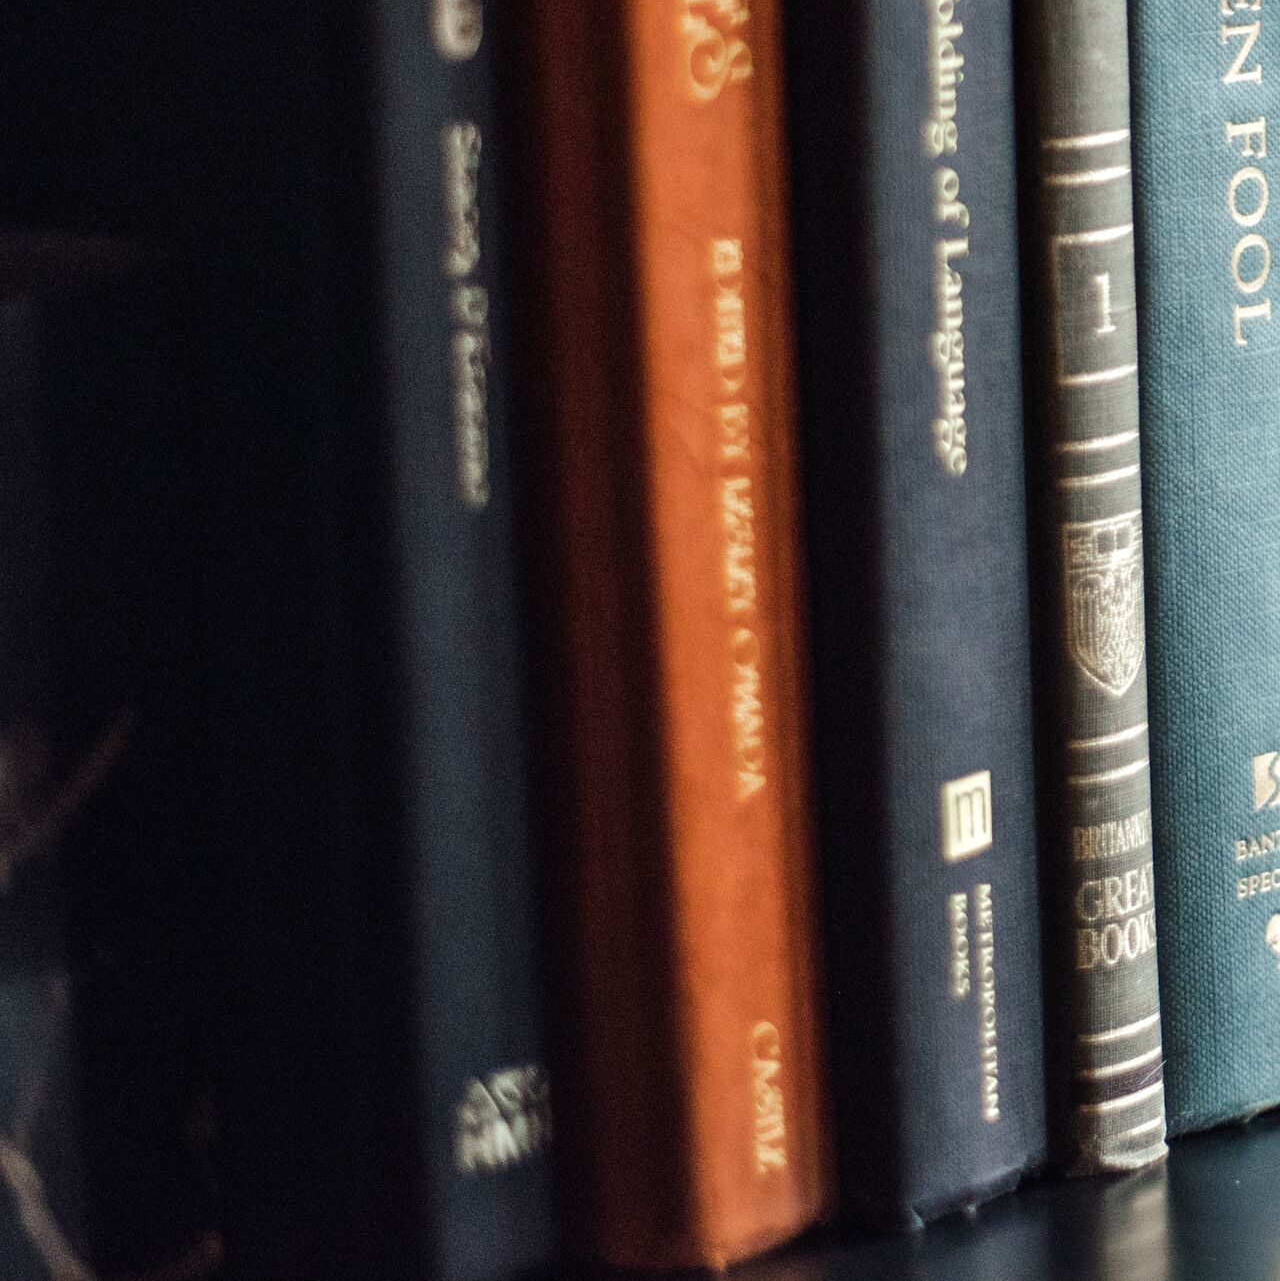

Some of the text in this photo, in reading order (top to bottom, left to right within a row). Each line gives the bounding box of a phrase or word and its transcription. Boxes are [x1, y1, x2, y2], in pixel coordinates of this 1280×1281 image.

[934, 167, 970, 227] of
[1225, 116, 1272, 346] FOOL
[929, 237, 971, 477] Language
[1089, 273, 1117, 335] 1
[947, 892, 971, 998] BOOKS
[974, 883, 1001, 1121] METROPOLITAN
